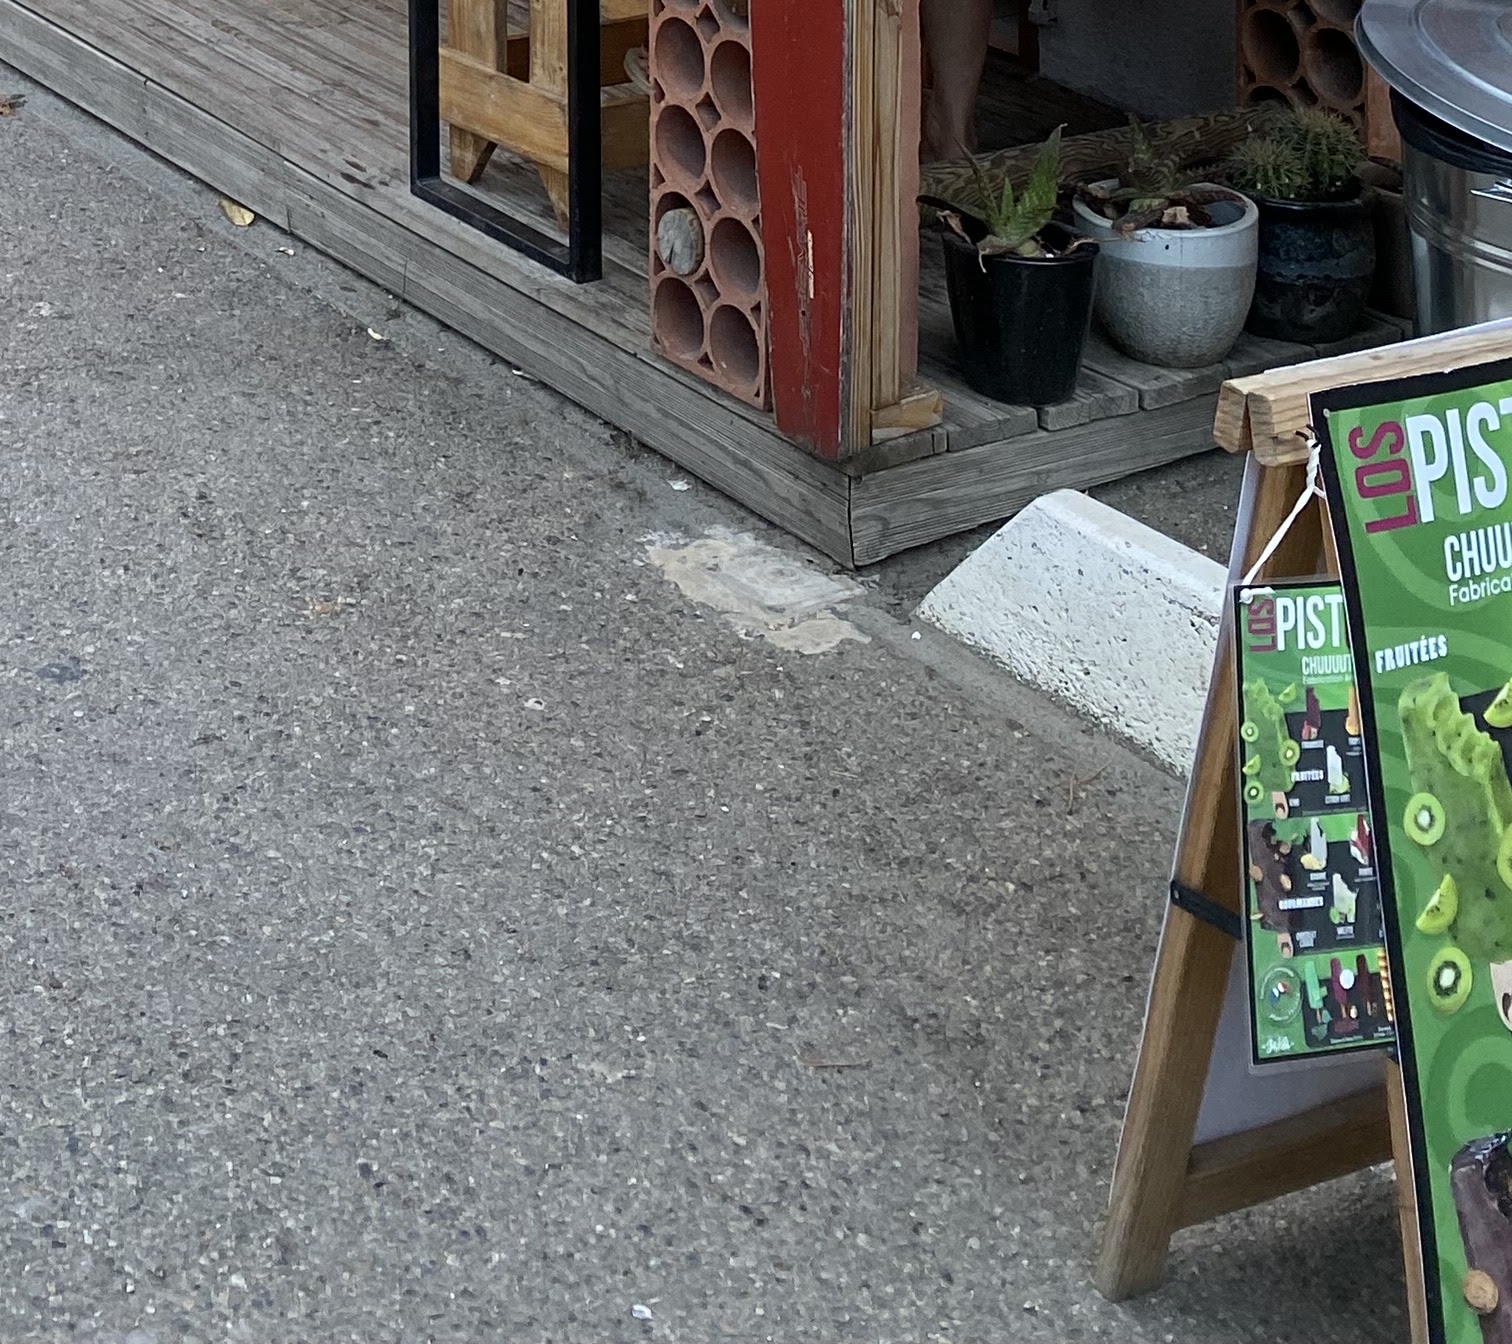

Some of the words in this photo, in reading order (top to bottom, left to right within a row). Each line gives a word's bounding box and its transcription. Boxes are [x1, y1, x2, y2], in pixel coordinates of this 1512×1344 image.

[1348, 420, 1417, 535] LOS
[1406, 395, 1512, 524] PIS
[1444, 522, 1512, 582] CHUU
[1449, 572, 1512, 606] Fabrica
[1250, 597, 1275, 652] LOS
[1276, 594, 1343, 651] PIST
[1375, 634, 1449, 673] FRUITÉES
